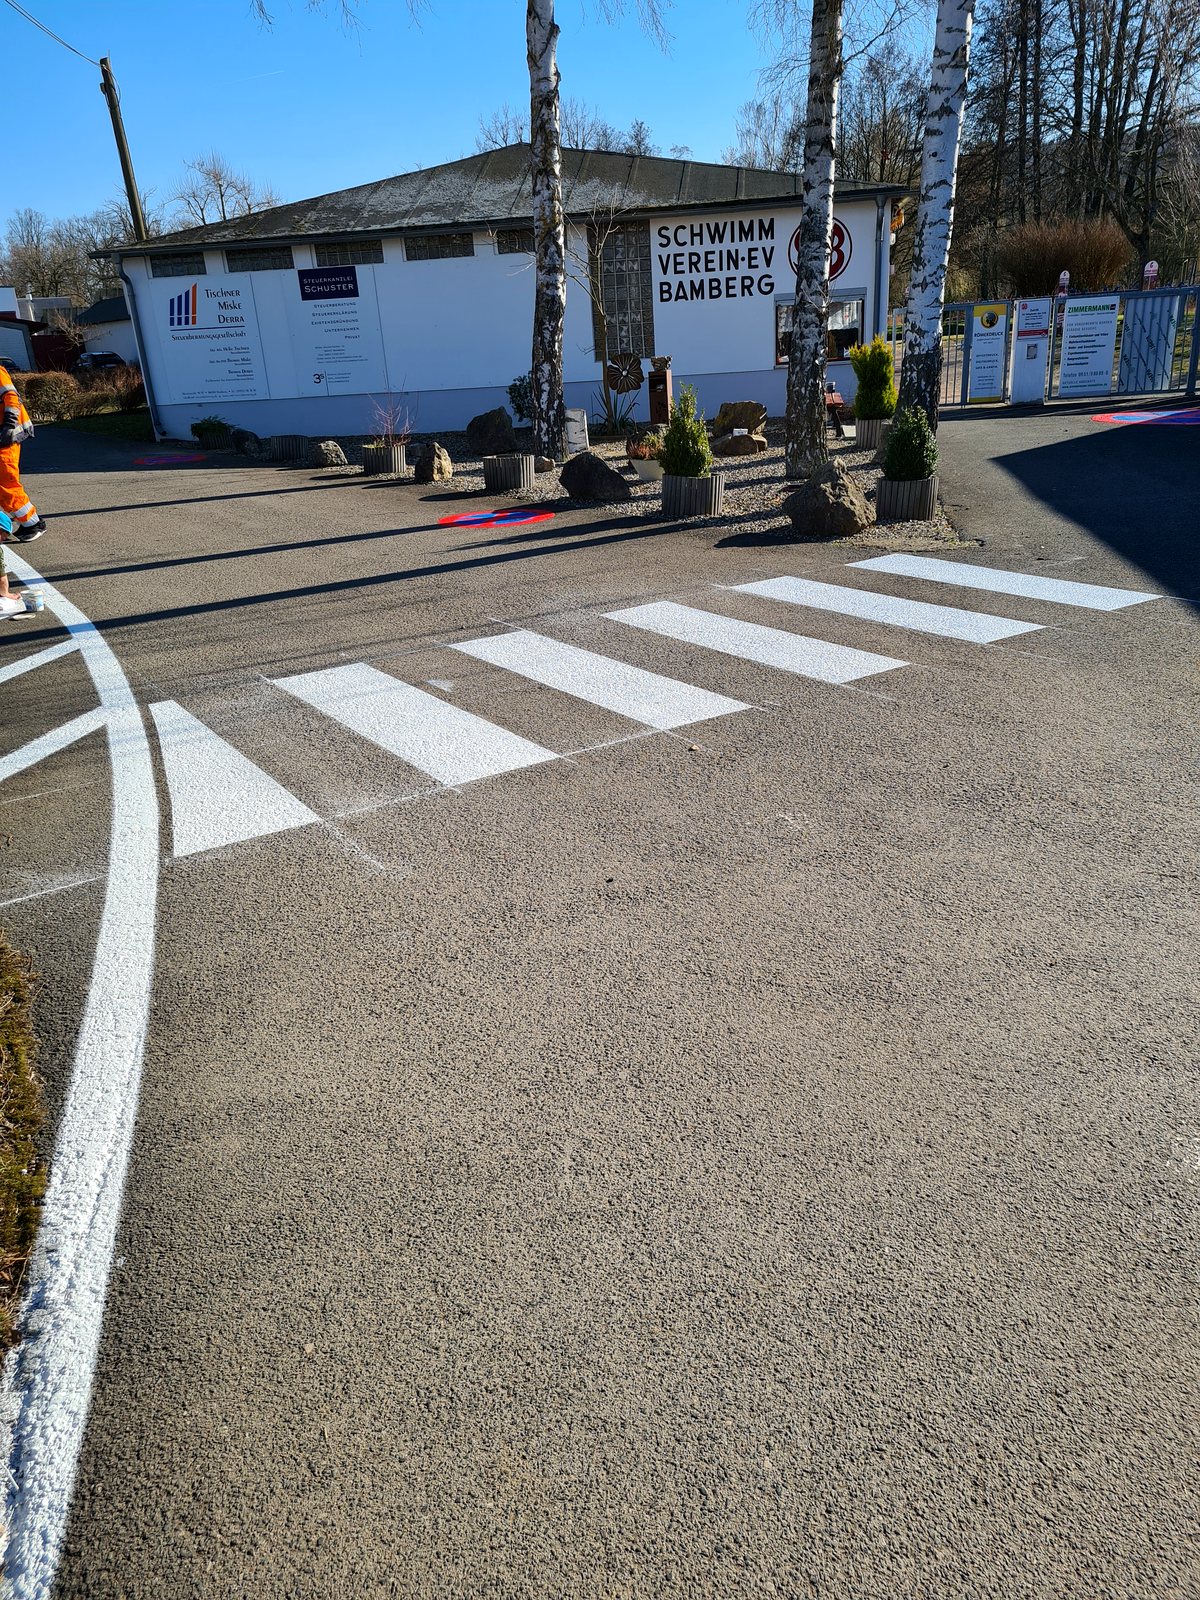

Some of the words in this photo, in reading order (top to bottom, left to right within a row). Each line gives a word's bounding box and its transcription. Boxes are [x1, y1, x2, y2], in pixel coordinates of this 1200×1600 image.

[657, 217, 775, 248] SCHWIMM
[304, 283, 354, 293] SCHUSTER
[659, 273, 775, 303] BAMBERG
[1067, 304, 1110, 314] ZIMMERMANN
